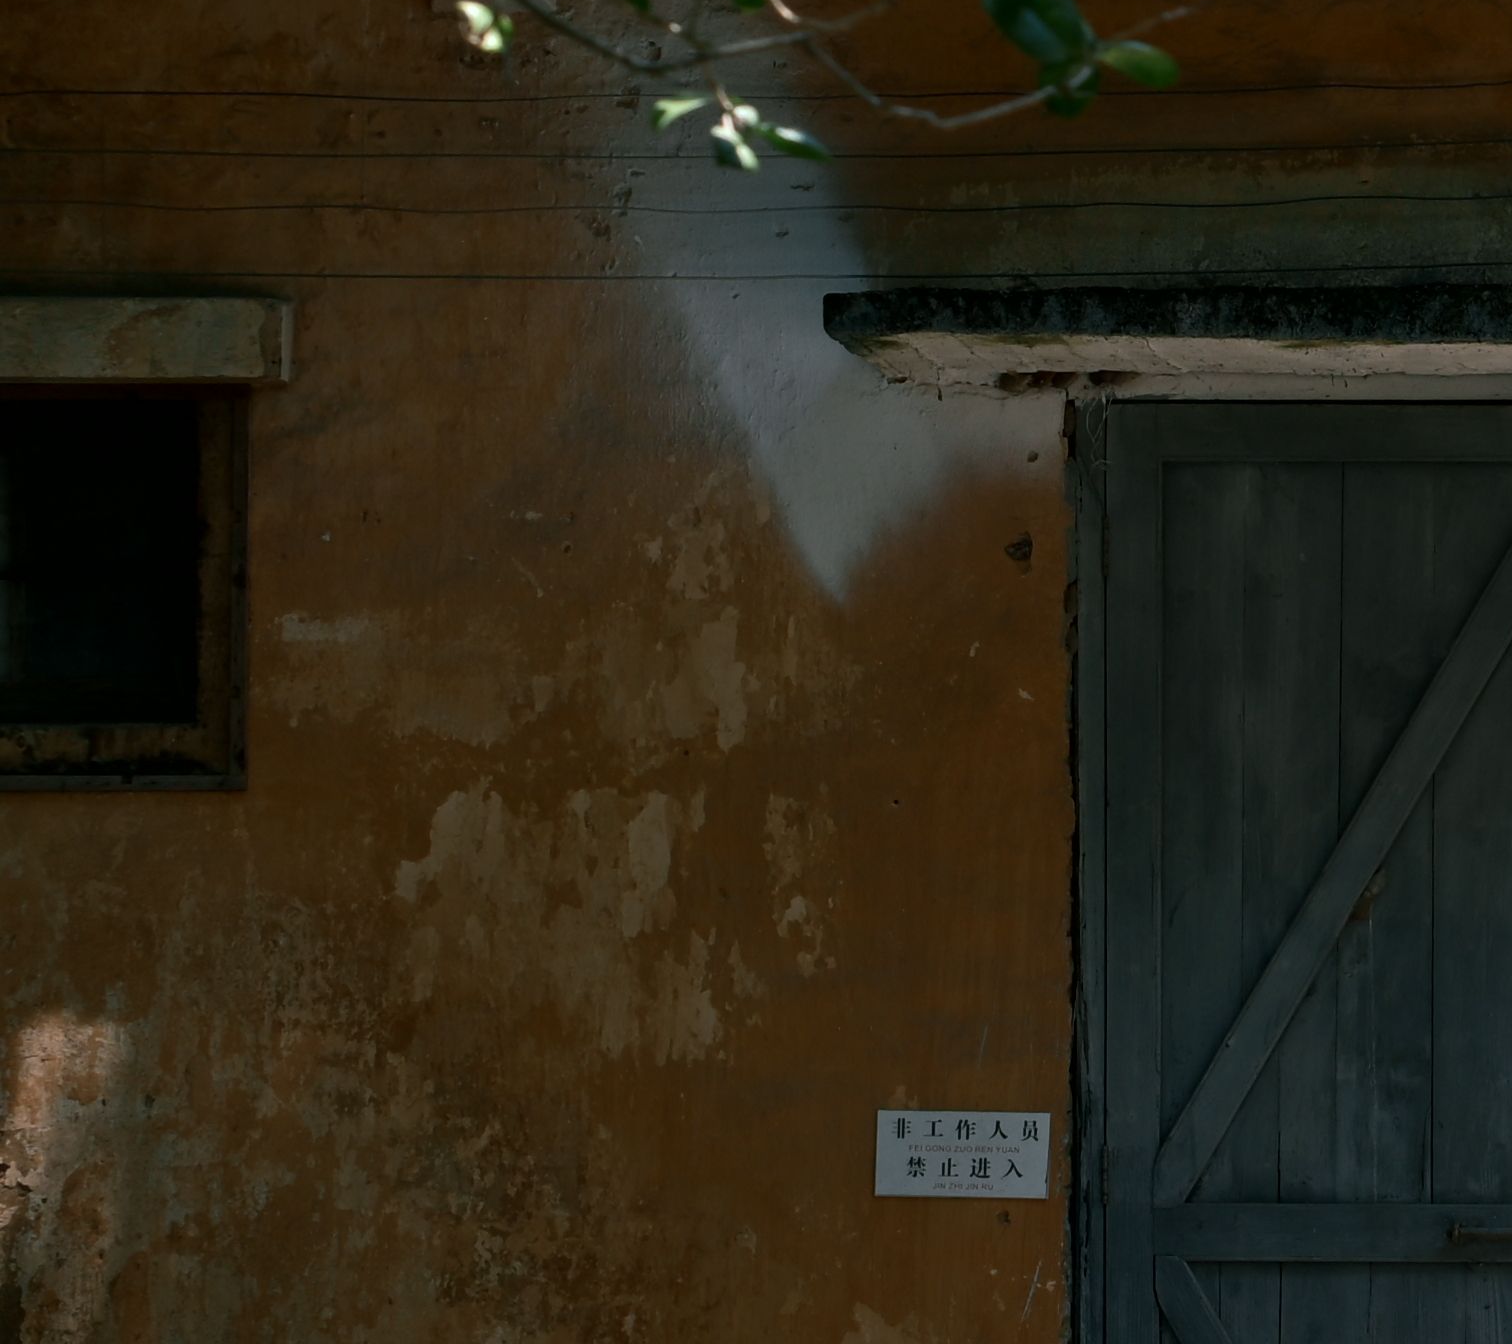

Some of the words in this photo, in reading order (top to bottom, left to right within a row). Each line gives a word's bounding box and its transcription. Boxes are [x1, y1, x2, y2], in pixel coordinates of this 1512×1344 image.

[891, 1117, 1039, 1142] 非工作人员
[908, 1144, 923, 1153] FEI
[925, 1144, 951, 1153] GONG
[953, 1145, 973, 1153] ZUO
[974, 1145, 993, 1153] REN
[995, 1146, 1020, 1154] YUAN
[906, 1156, 1024, 1179] 禁止进入
[932, 1182, 946, 1190] JIN
[948, 1182, 963, 1190] ZHI
[965, 1183, 979, 1191] JIN
[980, 1183, 994, 1191] RU
